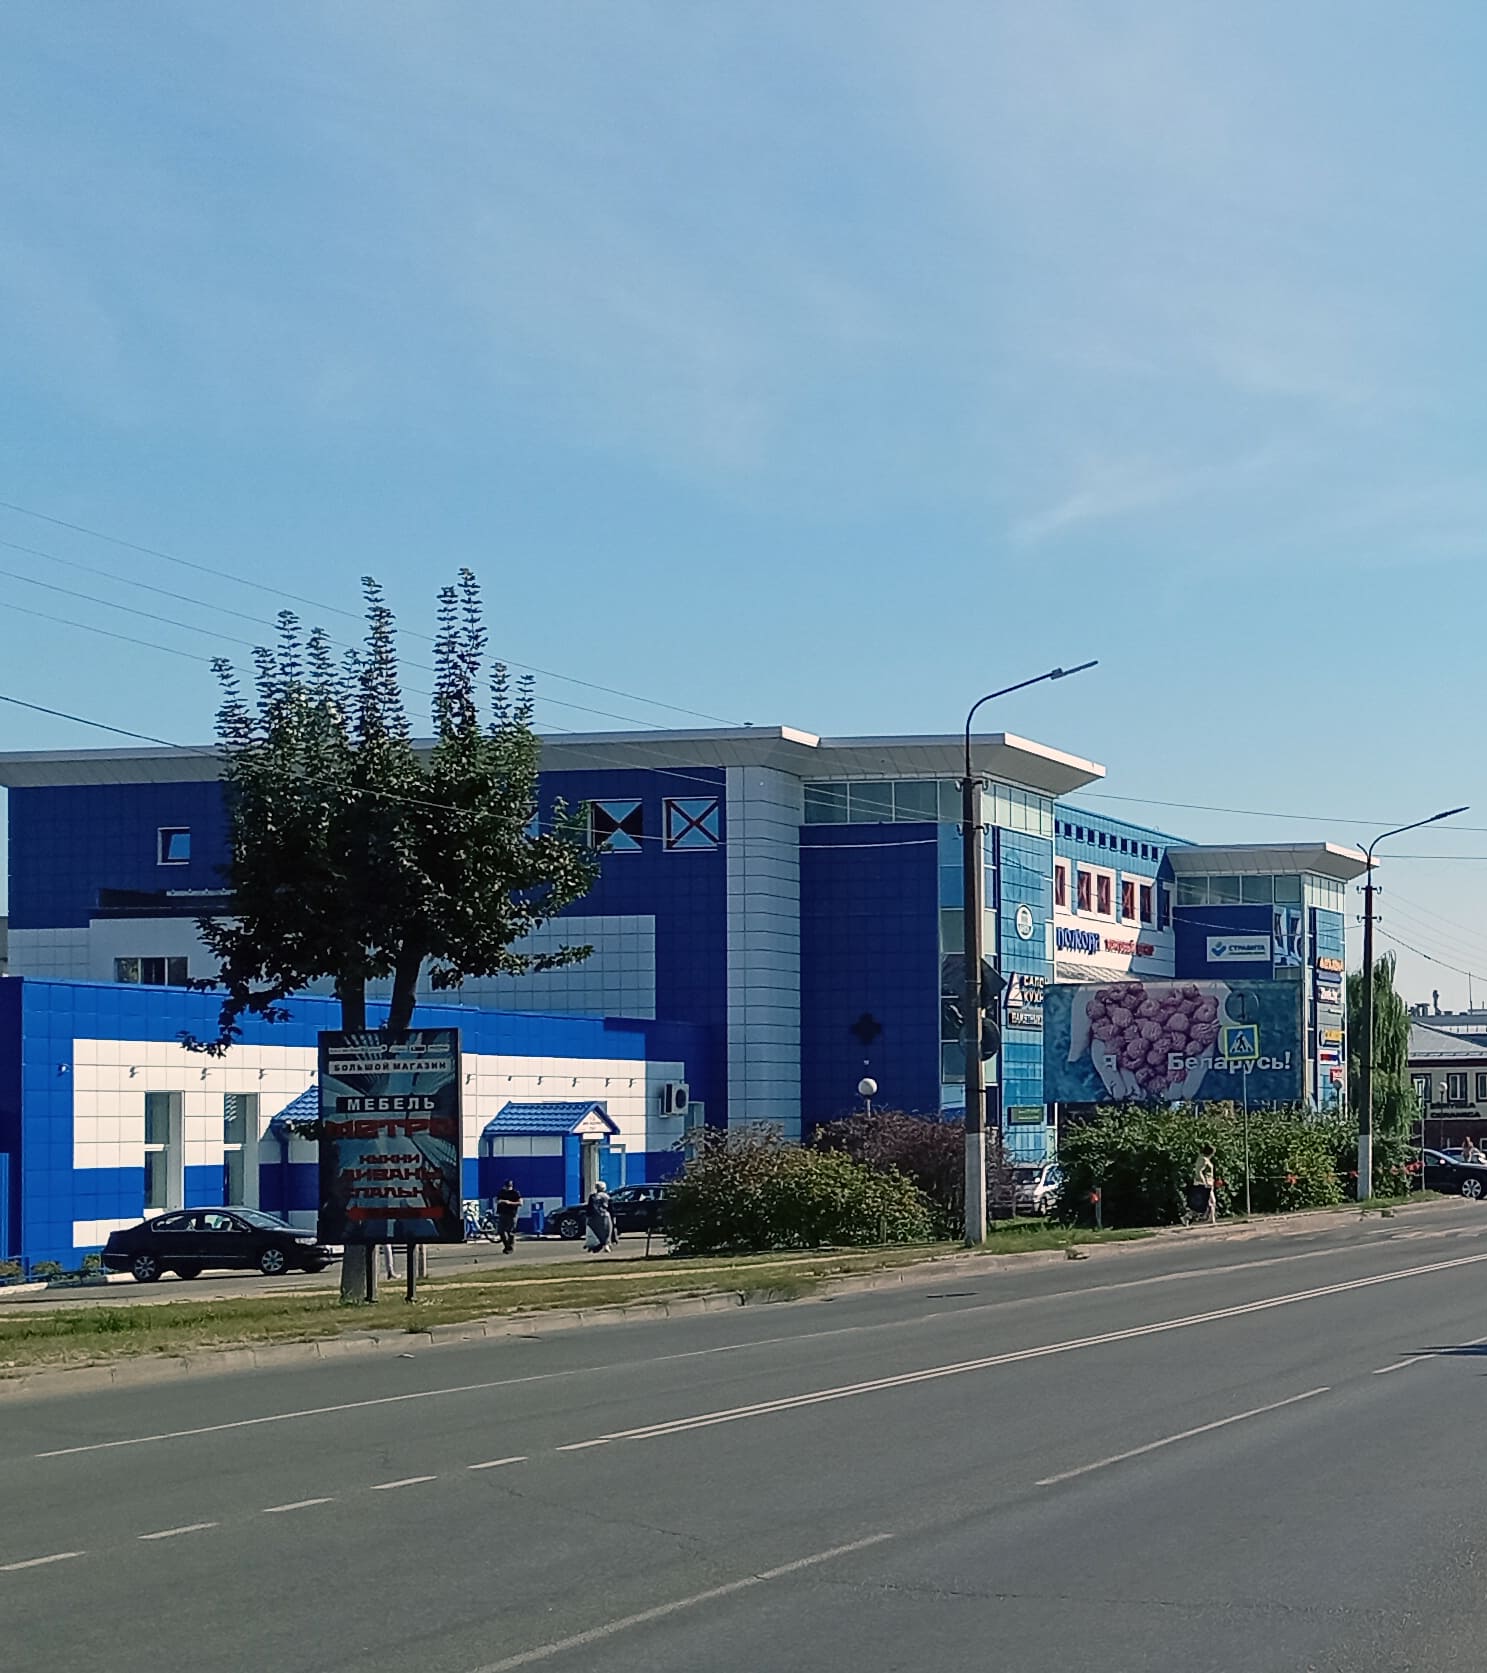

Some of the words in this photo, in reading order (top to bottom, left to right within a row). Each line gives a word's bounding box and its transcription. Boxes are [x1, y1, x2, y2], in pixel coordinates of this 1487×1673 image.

[334, 1062, 390, 1073] БОЛЬШОЙ
[393, 1061, 447, 1071] МАГАЗИН
[1167, 1051, 1292, 1074] Беларусь!
[347, 1097, 436, 1112] МЕБЕЛЬ
